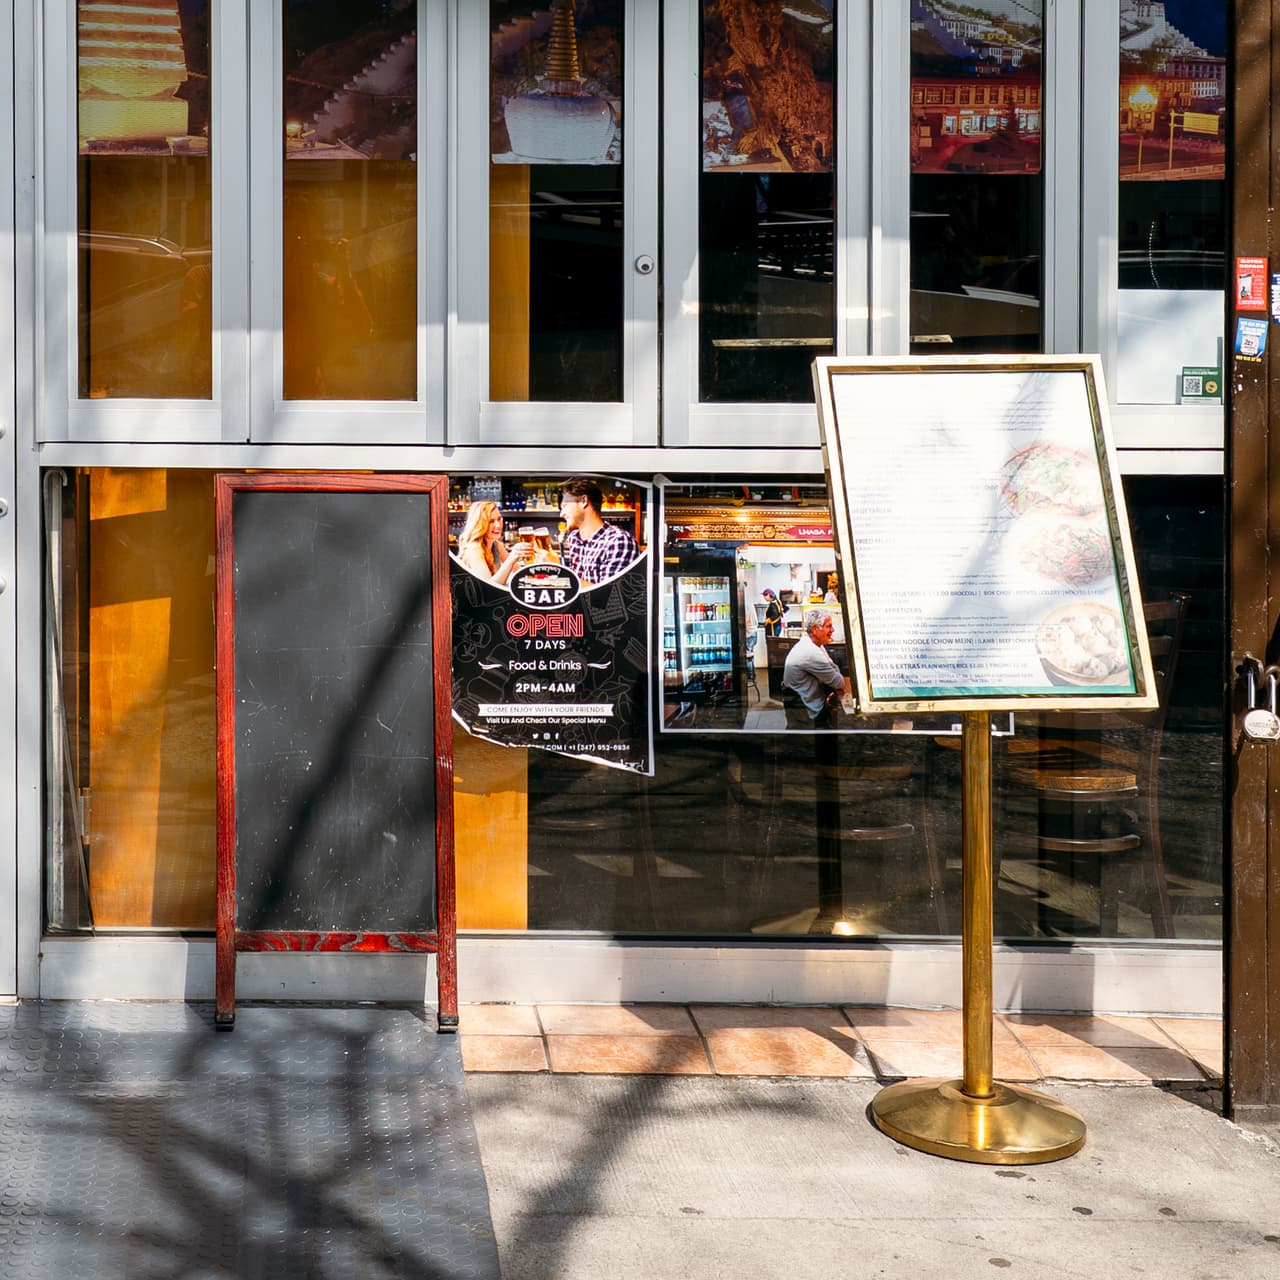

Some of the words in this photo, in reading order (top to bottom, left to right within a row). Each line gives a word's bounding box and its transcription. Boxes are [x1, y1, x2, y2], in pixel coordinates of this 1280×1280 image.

[524, 590, 566, 604] BAR
[507, 614, 584, 638] OPEN
[524, 640, 531, 650] 7
[535, 640, 566, 650] DAYS
[509, 661, 536, 671] Food
[538, 661, 547, 670] &
[550, 661, 582, 671] Drinks
[516, 683, 575, 693] 2PM-4AM
[561, 717, 586, 725] Special
